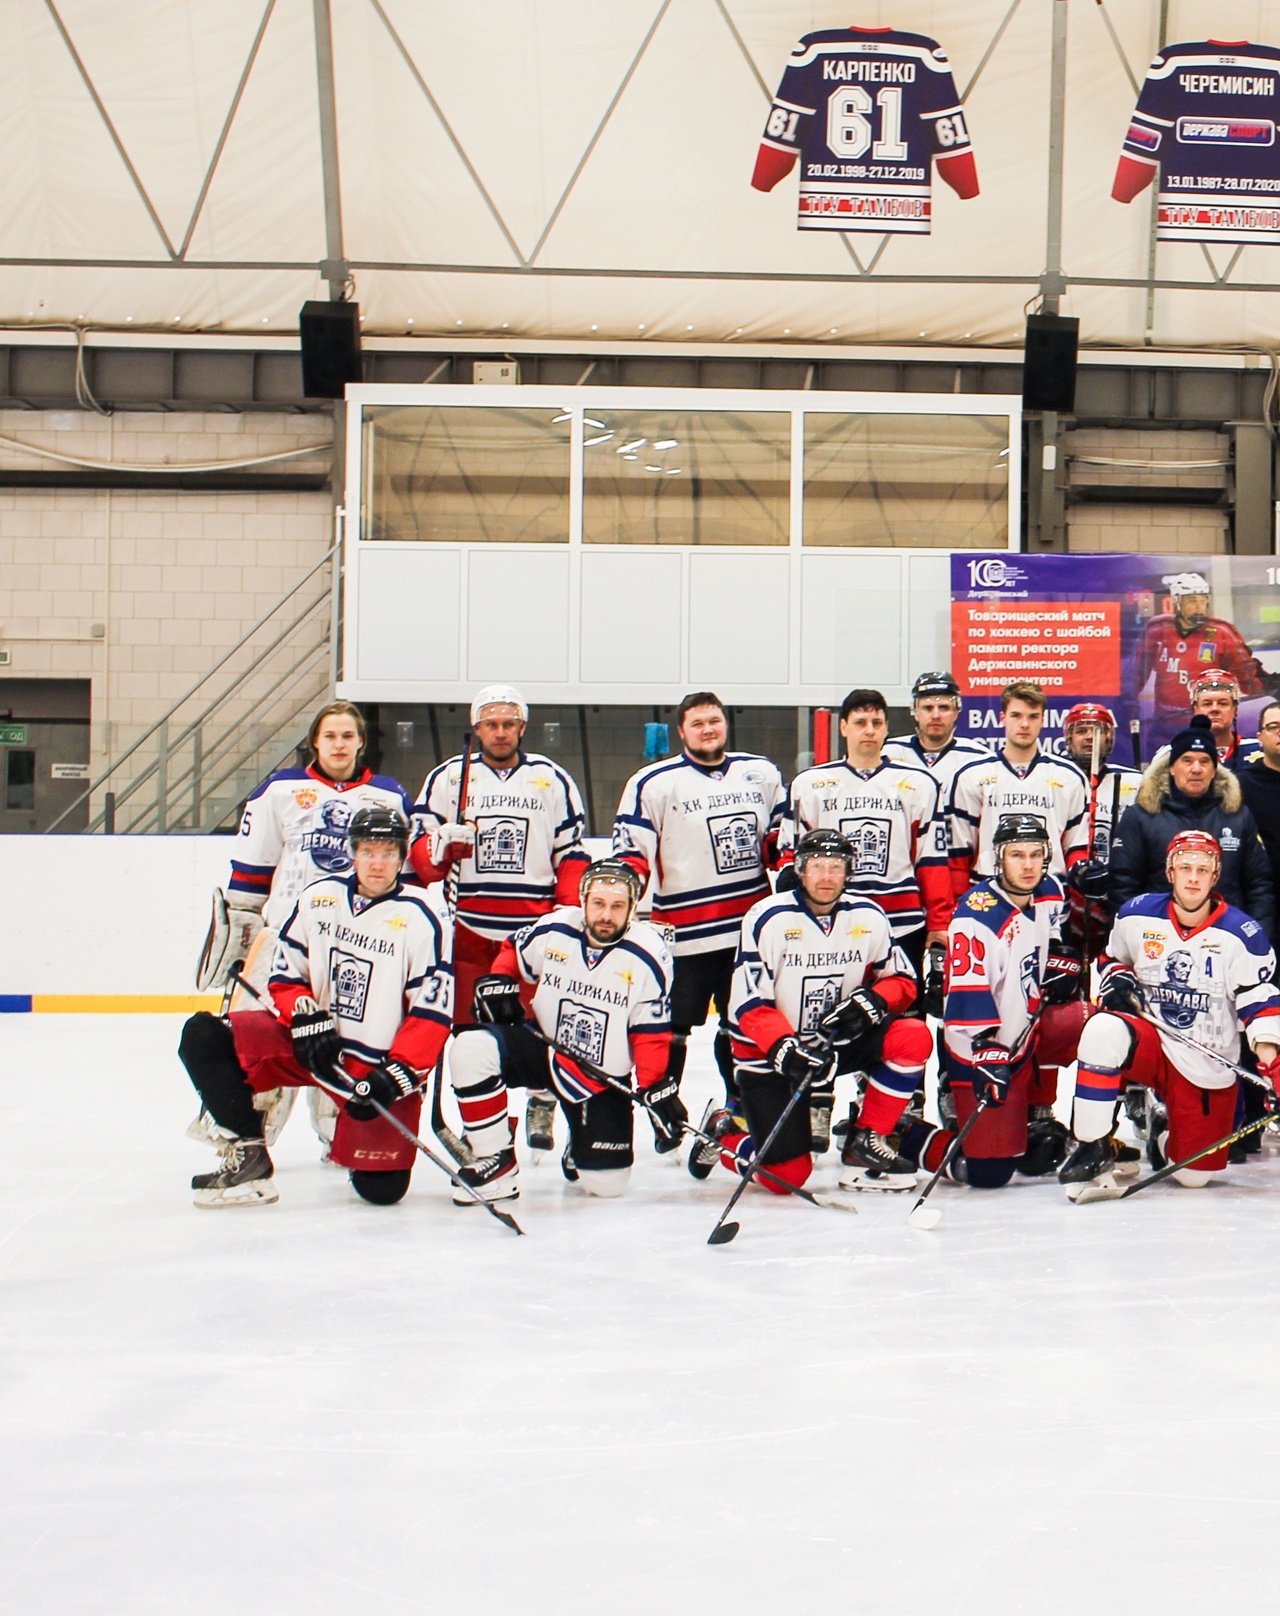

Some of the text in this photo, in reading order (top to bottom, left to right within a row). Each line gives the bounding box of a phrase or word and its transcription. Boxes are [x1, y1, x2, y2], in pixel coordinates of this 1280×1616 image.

[823, 60, 916, 83] КАРПЕНКО
[1179, 74, 1275, 95] ЧЕРЕМИСИН
[767, 108, 800, 141] 61
[826, 85, 908, 161] 61
[935, 115, 970, 146] 61
[807, 164, 925, 180] 20.02.1998-27.12.2019
[1167, 175, 1280, 191] 13.01.1987-28.07.2020
[807, 196, 924, 218] ТГУ ТАМБОВ
[1166, 207, 1280, 229] ТГУ ТАМБОВ
[967, 609, 1105, 624] Товарищеский матч
[968, 625, 1111, 637] по хоккею с шайбой
[968, 643, 1079, 656] памяти ректора
[968, 659, 1077, 673] Державинского
[682, 799, 702, 815] ХК
[542, 972, 629, 1008] ХК ДЕРЖАВА
[592, 1142, 630, 1151] BAUER
[354, 1150, 400, 1160] CCM
